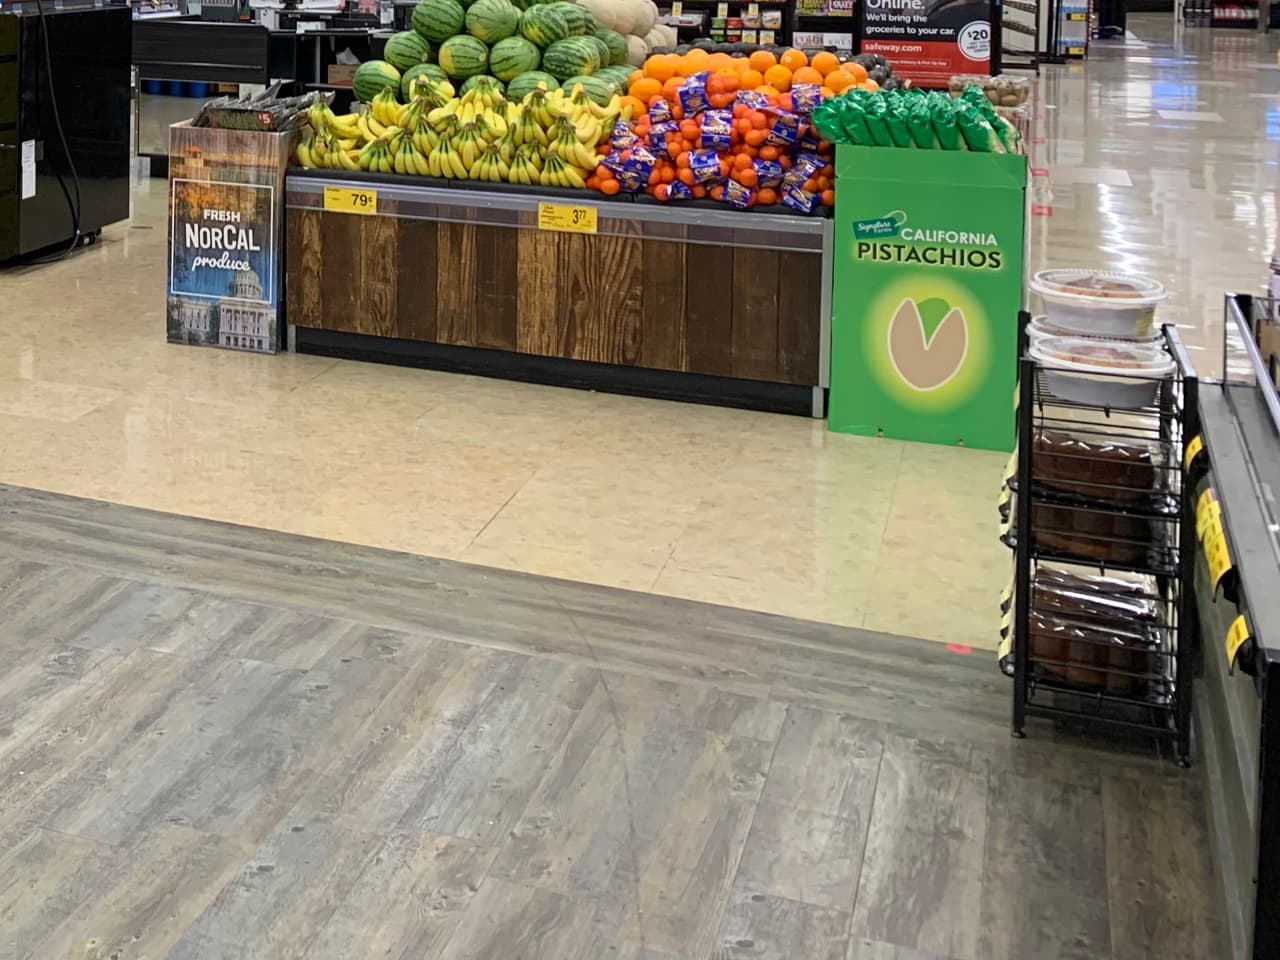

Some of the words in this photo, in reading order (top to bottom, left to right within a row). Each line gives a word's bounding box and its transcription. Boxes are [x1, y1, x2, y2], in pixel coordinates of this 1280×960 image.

[866, 13, 887, 22] We'll
[888, 13, 911, 24] bring
[913, 13, 928, 23] the
[865, 25, 905, 35] groceries
[907, 26, 916, 34] to
[918, 27, 938, 36] your
[939, 27, 955, 35] car.
[967, 29, 988, 41] $20
[865, 42, 922, 53] safeway.com
[258, 113, 271, 124] $5
[203, 208, 241, 222] FRESH
[901, 228, 998, 246] CALIFORNIA
[191, 251, 251, 272] produce
[857, 242, 1001, 269] PISTACHIOS
